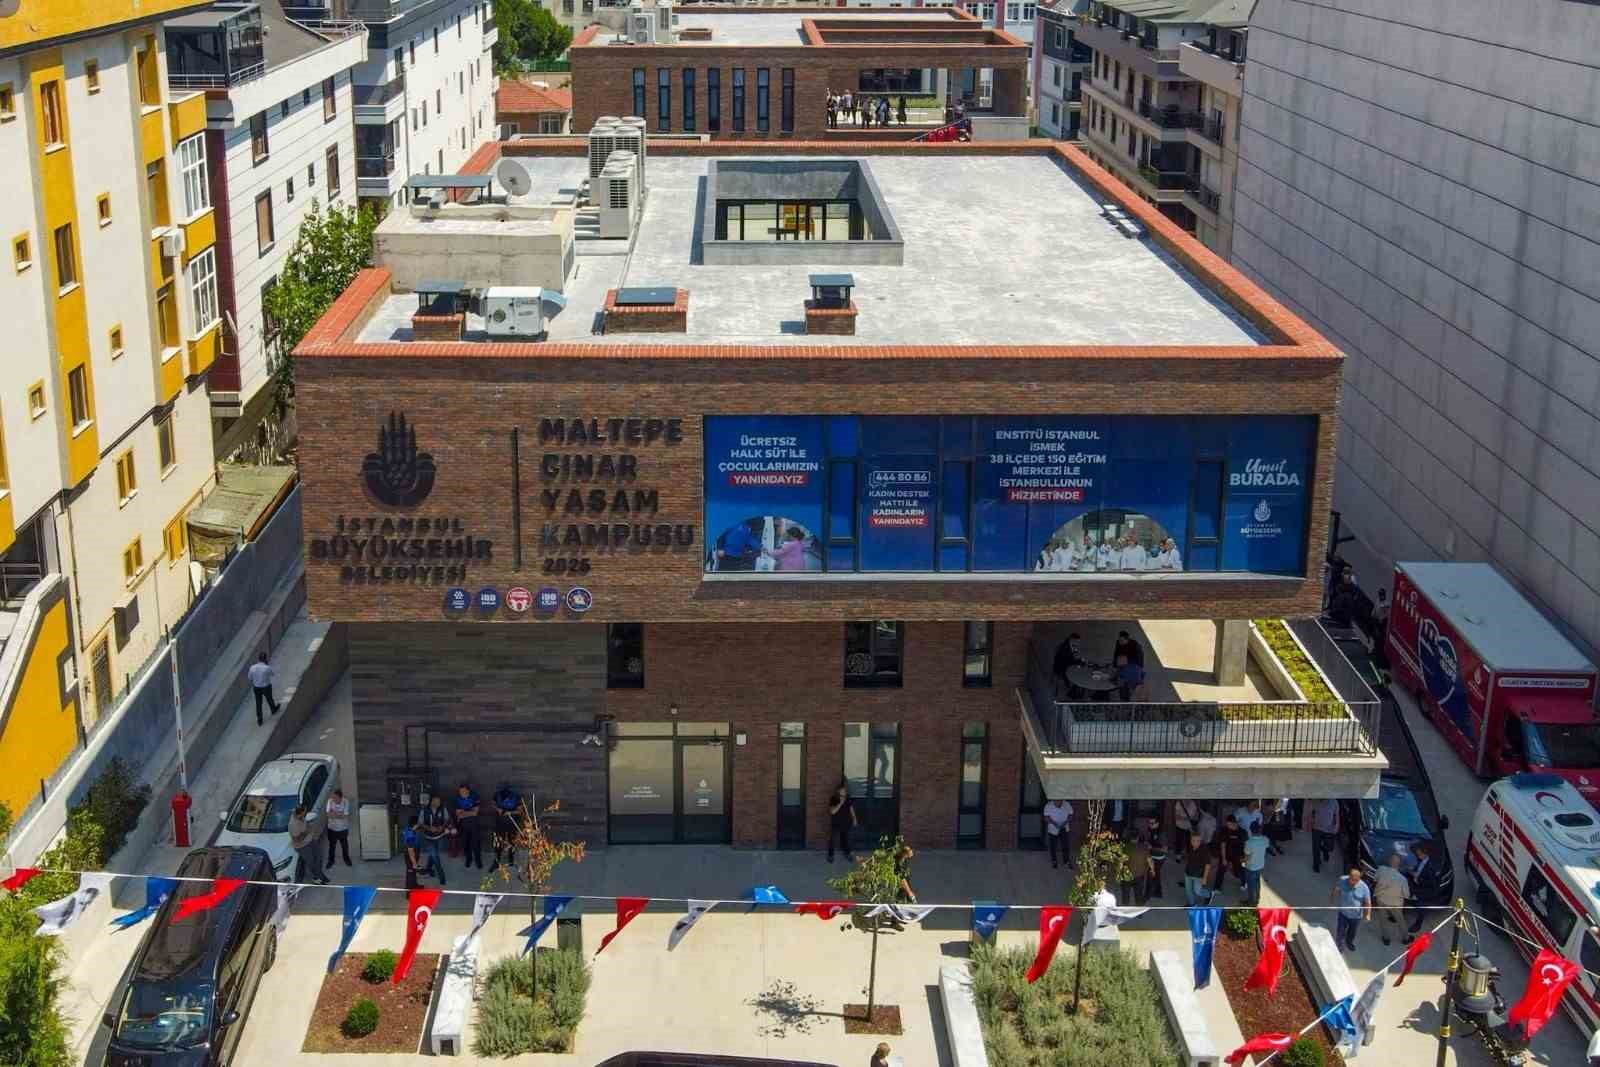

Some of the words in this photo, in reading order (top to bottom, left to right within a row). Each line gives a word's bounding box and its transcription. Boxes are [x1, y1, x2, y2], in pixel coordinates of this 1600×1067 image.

[539, 417, 683, 443] MALTEPE
[1045, 429, 1100, 440] İSTANBUL
[740, 435, 797, 446] ÜCRETSİZ
[1029, 441, 1065, 451] İSMEK
[730, 449, 762, 458] HALK
[765, 447, 787, 458] SÜT
[789, 447, 807, 458] İLE
[1005, 454, 1046, 465] İLÇEDE
[1067, 452, 1107, 464] EĞİTİM
[718, 462, 819, 473] ÇOCUKLARIMIZIN
[1012, 464, 1062, 475] MERKEZİ
[733, 474, 804, 484] YANINDAYIZ
[875, 472, 897, 481] 444
[1229, 473, 1301, 486] BURADA
[1011, 490, 1080, 500] HİZMETİNDE
[873, 517, 924, 525] YANINDAYIZ
[543, 557, 592, 574] 2025
